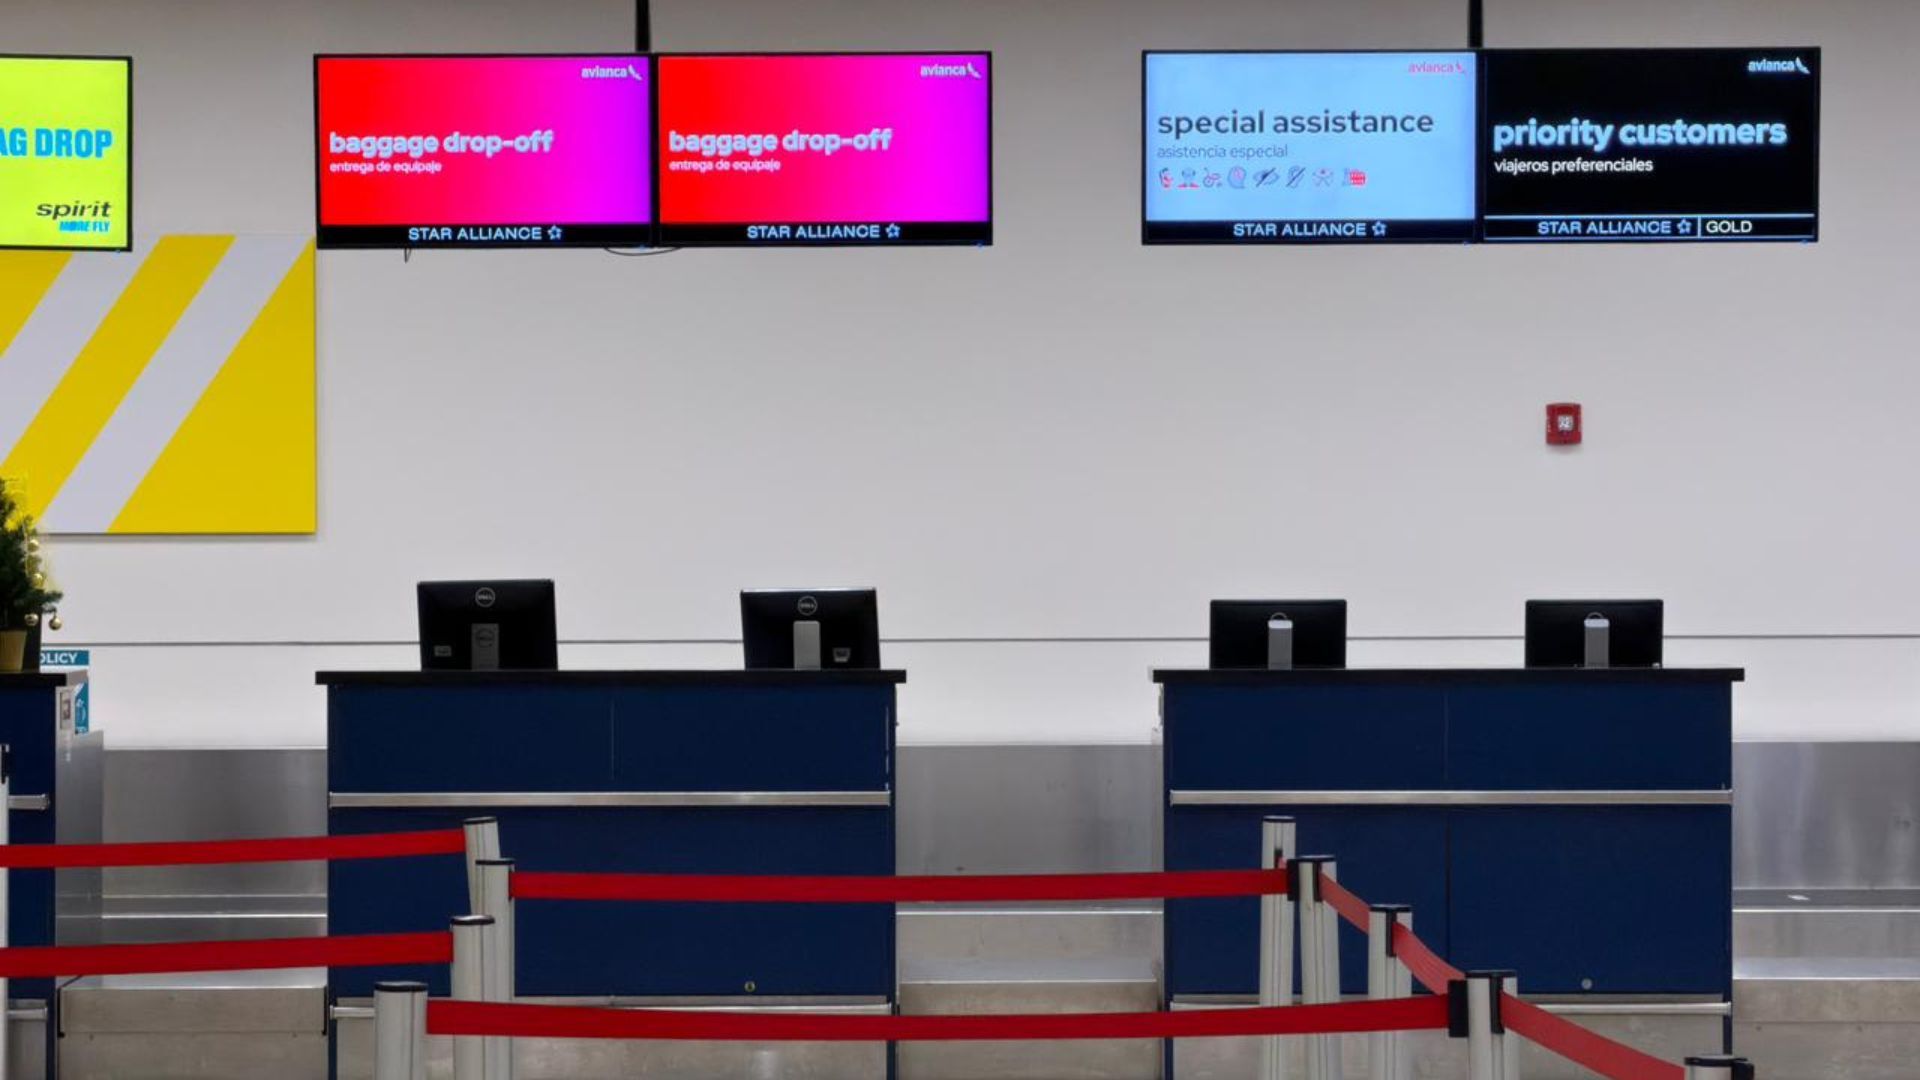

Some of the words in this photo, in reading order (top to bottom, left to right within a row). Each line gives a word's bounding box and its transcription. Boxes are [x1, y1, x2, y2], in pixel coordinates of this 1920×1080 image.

[581, 65, 627, 79] avianca
[920, 64, 966, 77] avianca
[1408, 62, 1454, 74] avianca
[1748, 59, 1794, 72] avianca
[1158, 109, 1264, 139] special
[1273, 109, 1434, 133] assistance
[669, 130, 778, 156] baggage
[782, 128, 893, 156] drop-off
[1493, 118, 1614, 152] priority
[1619, 120, 1788, 145] customers
[35, 129, 113, 158] DROP
[329, 132, 439, 158] baggage
[443, 130, 554, 158] drop-off
[1157, 145, 1227, 158] asistencia
[1229, 145, 1288, 161] especial
[329, 162, 375, 175] entrega
[376, 161, 392, 173] de
[393, 161, 443, 175] equipaje
[669, 160, 714, 173] entrega
[715, 159, 731, 171] de
[732, 159, 781, 173] equipaje
[1494, 159, 1549, 175] viajeros
[1551, 158, 1653, 175] preferenciales
[36, 200, 111, 220] spirit
[408, 227, 453, 240] STAR
[457, 227, 542, 240] ALLIANCE
[747, 225, 791, 239] STAR
[795, 225, 880, 238] ALLIANCE
[1233, 223, 1277, 237] STAR
[1282, 223, 1366, 236] ALLIANCE
[1538, 221, 1582, 235] STAR
[1586, 221, 1671, 234] ALLIANCE
[1706, 221, 1753, 233] GOLD
